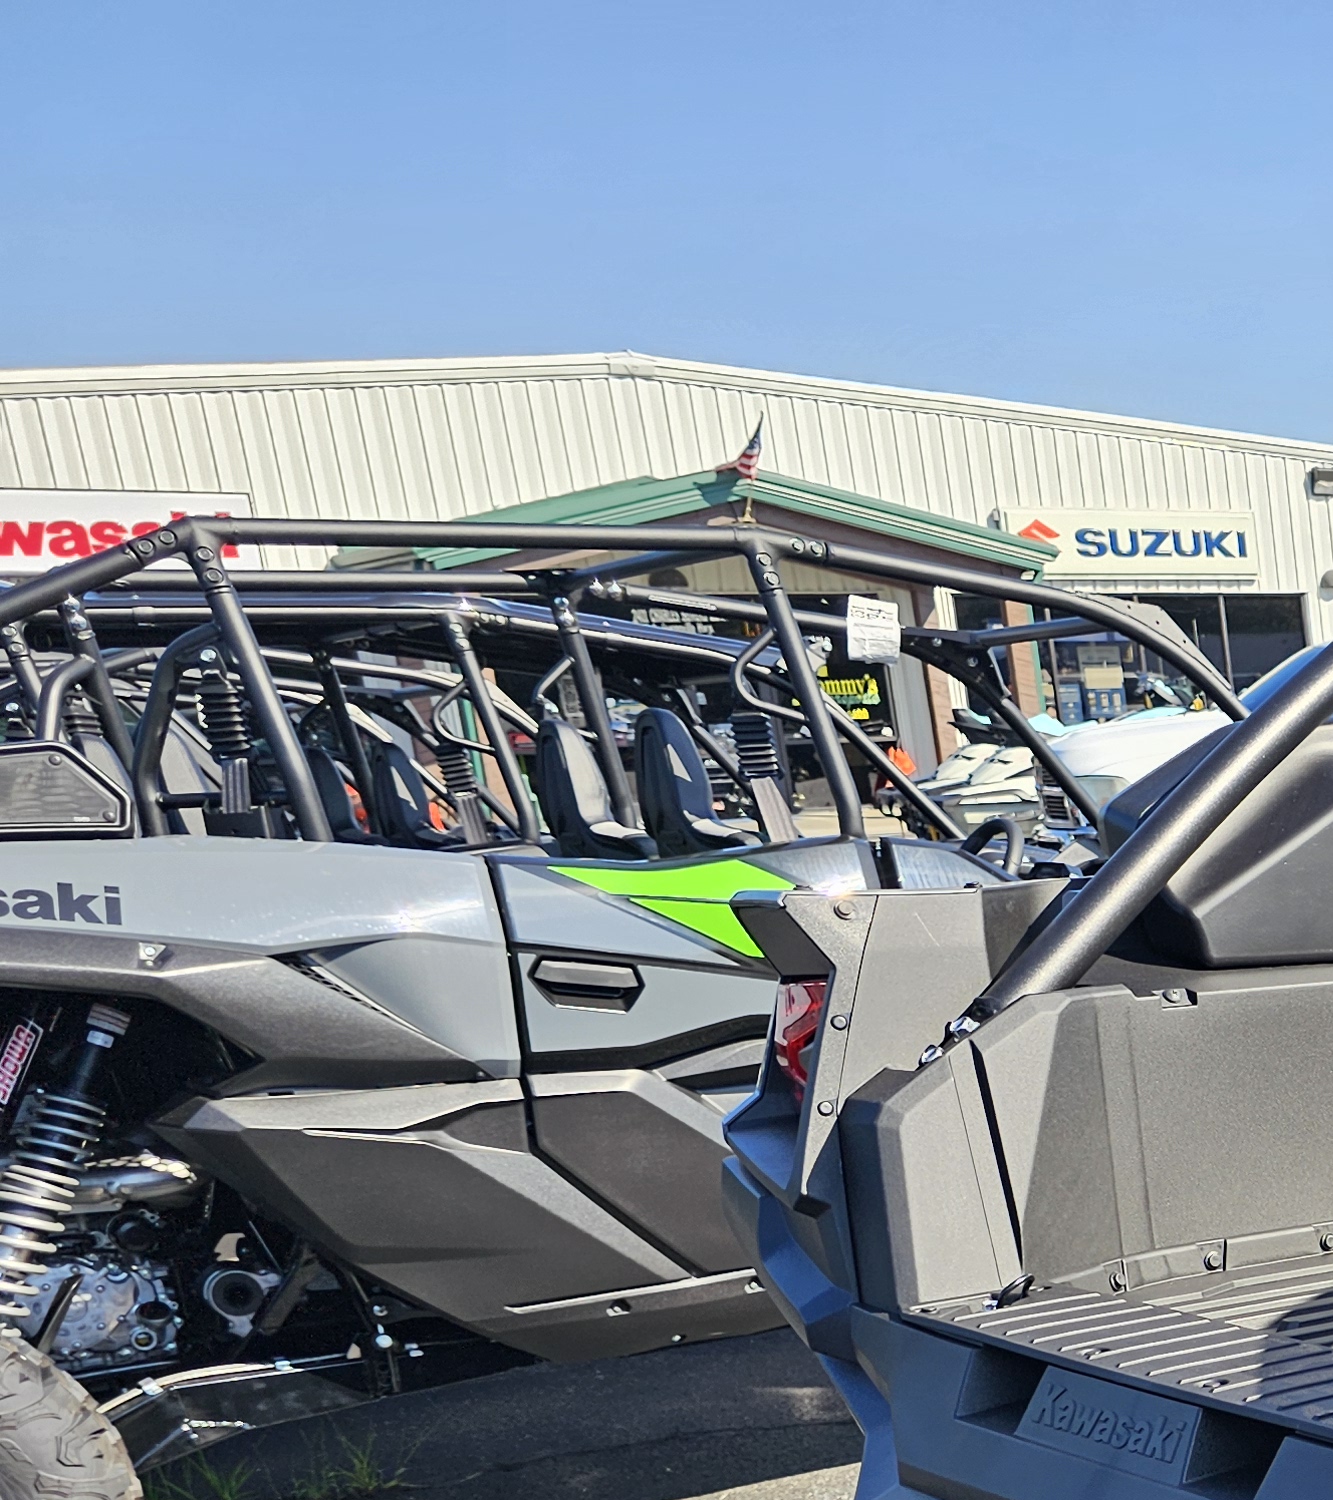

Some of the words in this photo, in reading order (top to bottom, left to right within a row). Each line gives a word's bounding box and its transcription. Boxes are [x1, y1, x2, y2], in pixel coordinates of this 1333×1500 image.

[1075, 528, 1248, 558] SUZUKI
[0, 882, 122, 925] aki
[1031, 1382, 1188, 1464] Kawasaki
